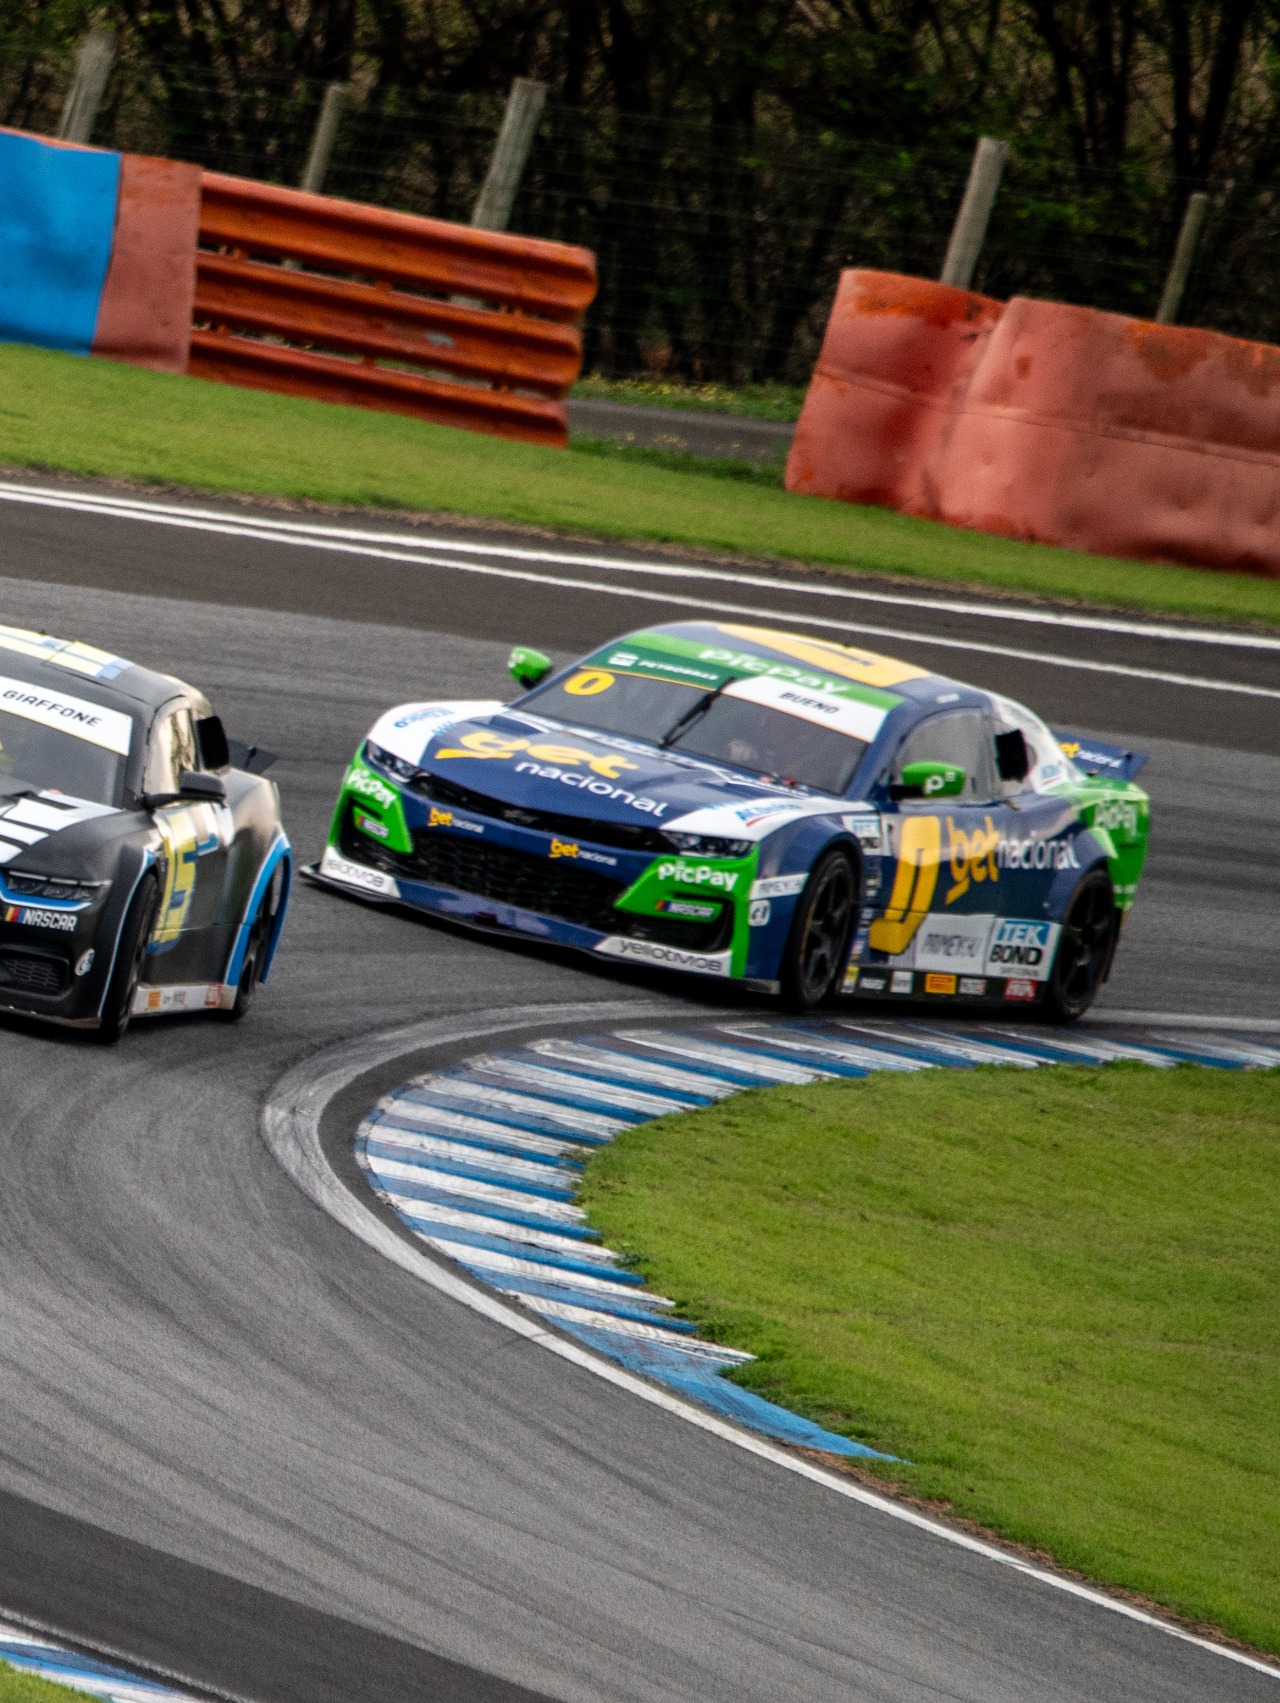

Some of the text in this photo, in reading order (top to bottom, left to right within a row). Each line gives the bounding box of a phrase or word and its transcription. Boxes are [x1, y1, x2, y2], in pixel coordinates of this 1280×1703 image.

[564, 671, 615, 696] 0
[698, 648, 851, 694] PicPay
[2, 689, 103, 728] GIAFFONE
[778, 692, 840, 714] BUENO
[514, 760, 669, 817] nacional
[657, 860, 739, 892] PicPay
[22, 908, 78, 932] NASCAR
[1000, 922, 1046, 947] TEK
[990, 944, 1043, 966] BOND
